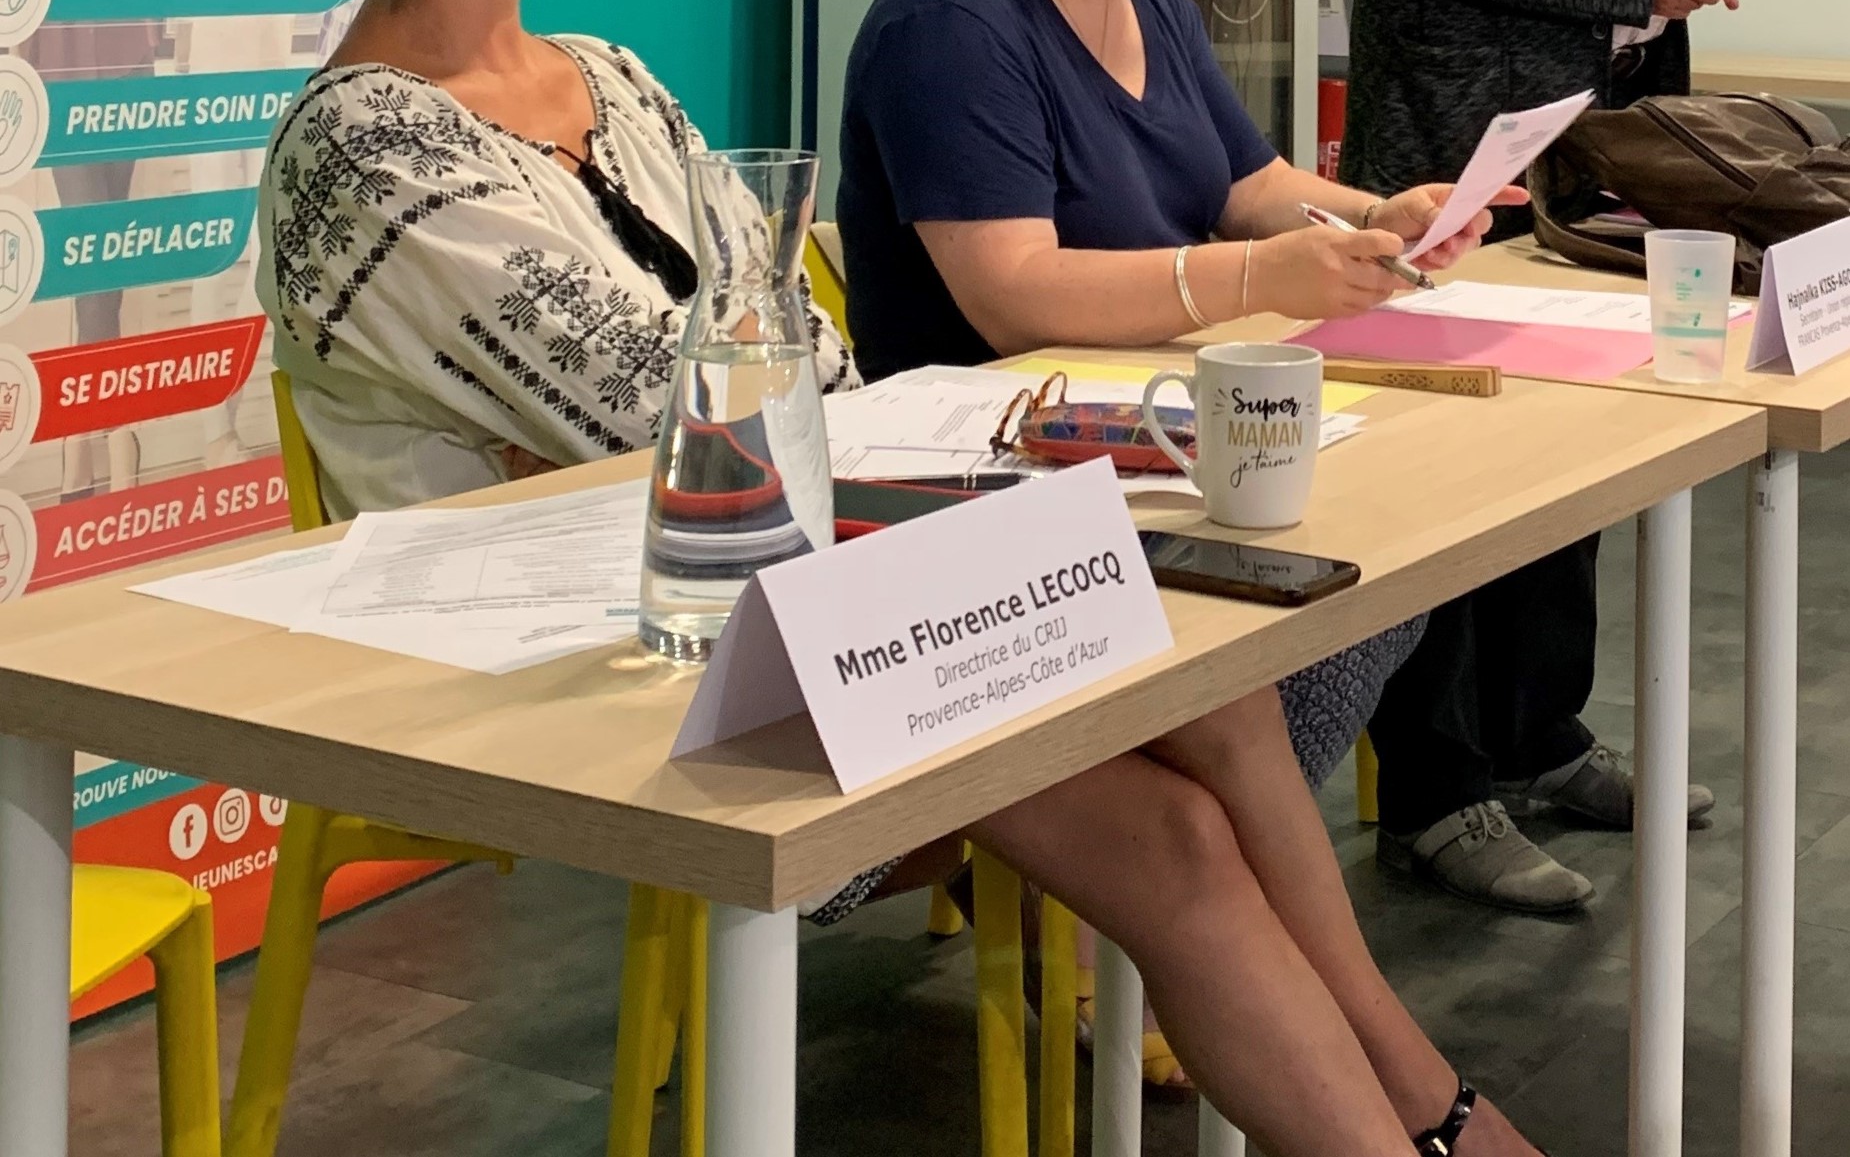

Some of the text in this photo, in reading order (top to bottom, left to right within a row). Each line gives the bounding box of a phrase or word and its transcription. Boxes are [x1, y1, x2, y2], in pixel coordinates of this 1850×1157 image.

[66, 98, 189, 135] PRENDRE
[194, 93, 254, 125] SOIN
[63, 217, 235, 266] SE DÉPLACER
[59, 348, 234, 407] SE DISTRAIRE
[1231, 387, 1301, 422] Super
[1227, 420, 1303, 448] MAMAN
[1230, 448, 1297, 488] je t'aime
[53, 496, 185, 558] ACCÉDER
[188, 486, 207, 523] À
[214, 480, 259, 518] SES
[833, 550, 1126, 686] Mme Florence LECOCQ
[934, 616, 1068, 689] Directrice du CRIJ
[907, 636, 1110, 737] Provence-Alpes-Côte d'Azur
[131, 767, 177, 790] NOU
